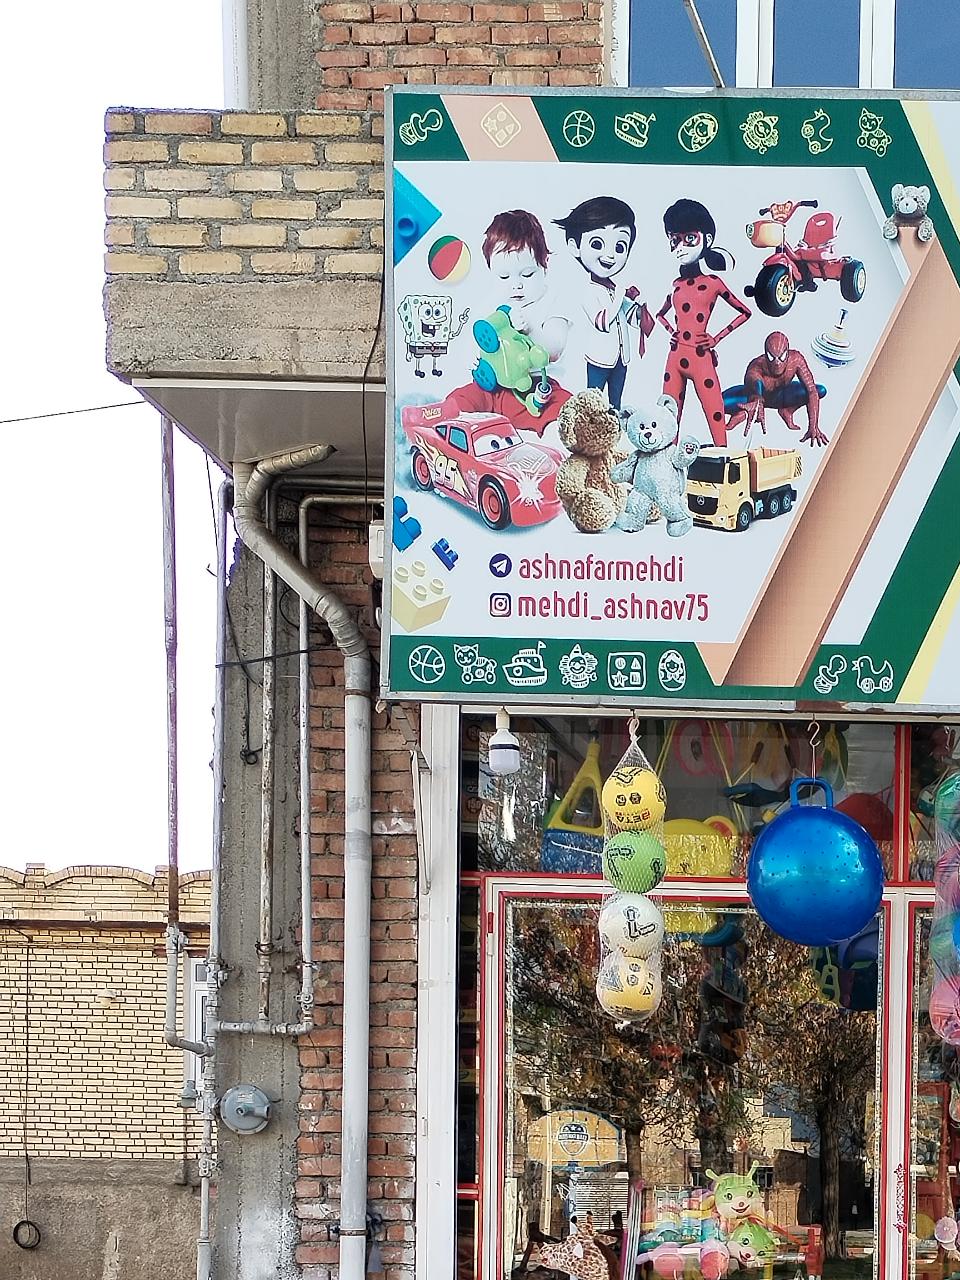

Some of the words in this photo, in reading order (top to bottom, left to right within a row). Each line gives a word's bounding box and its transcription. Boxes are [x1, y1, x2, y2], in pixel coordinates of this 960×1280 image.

[434, 455, 458, 487] 95
[518, 552, 683, 582] ashnafarmehdi
[517, 590, 709, 622] mehdi_ashnav75
